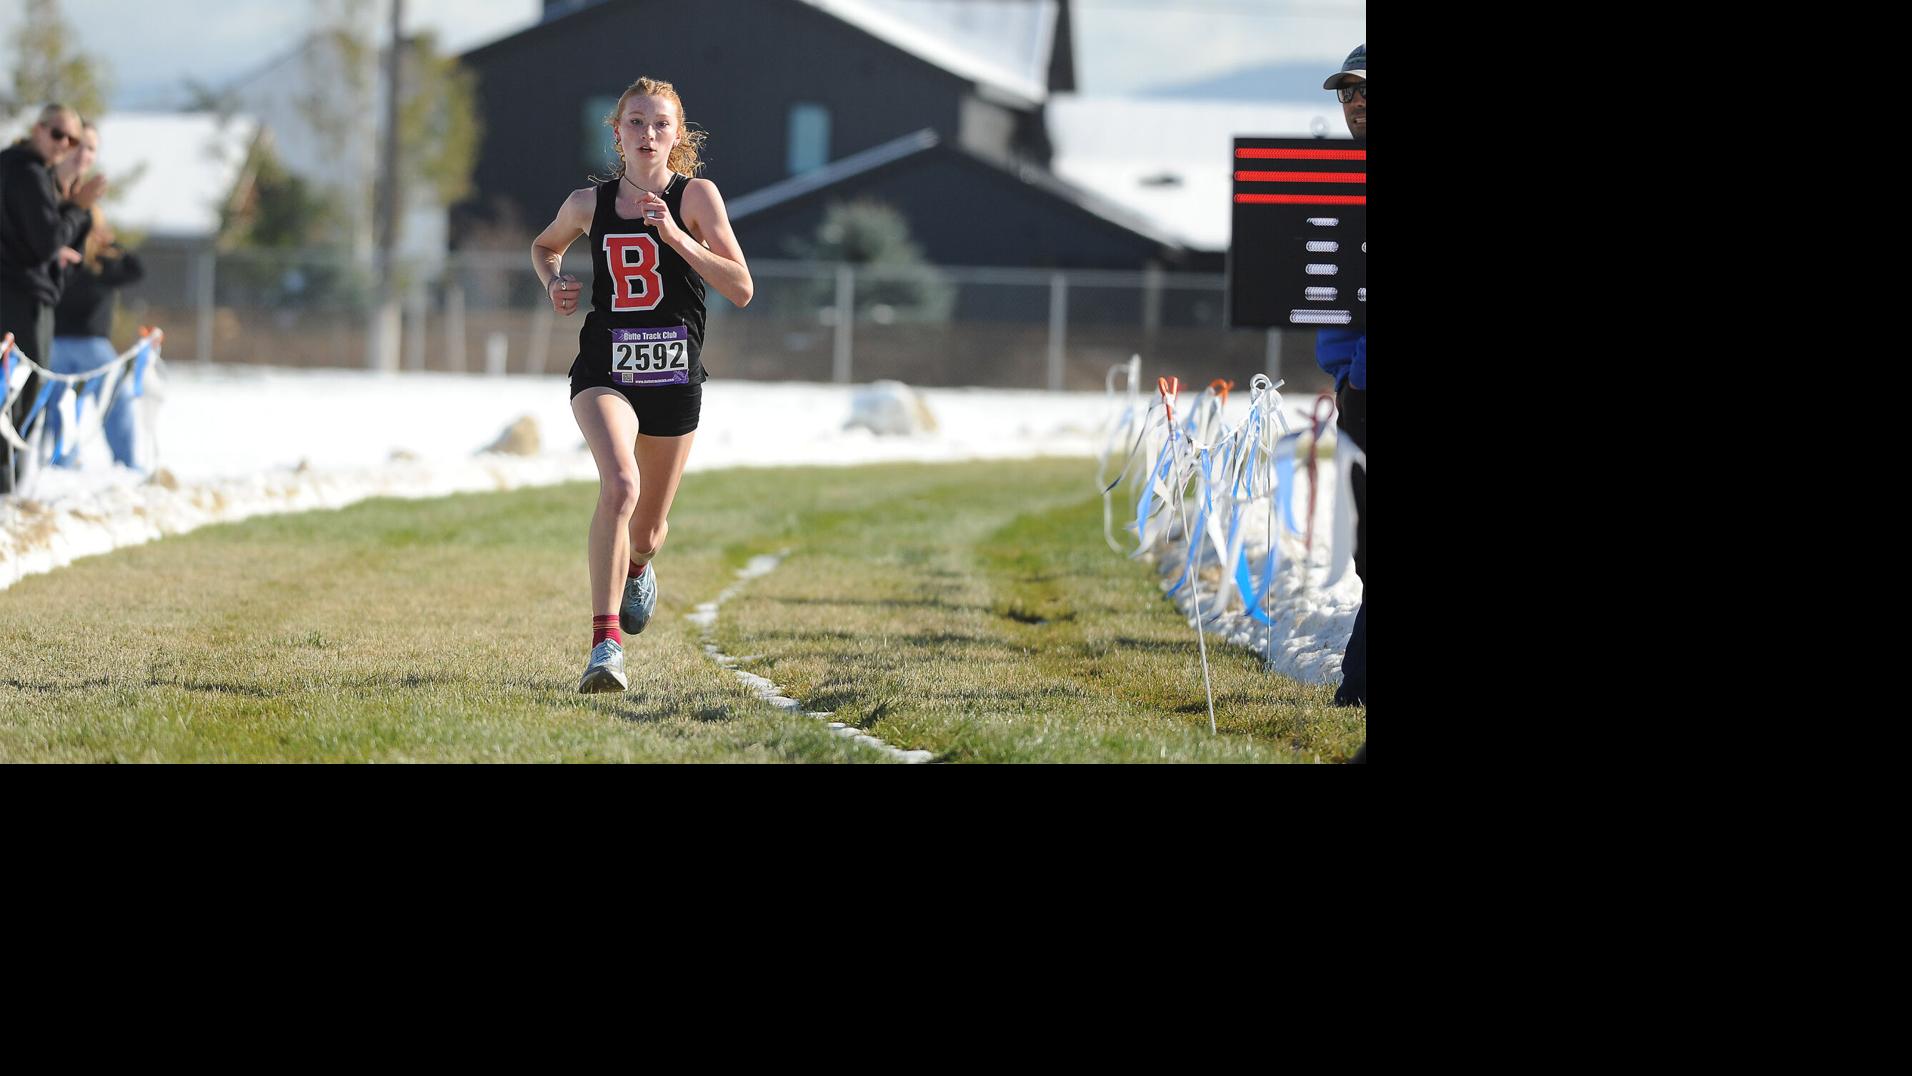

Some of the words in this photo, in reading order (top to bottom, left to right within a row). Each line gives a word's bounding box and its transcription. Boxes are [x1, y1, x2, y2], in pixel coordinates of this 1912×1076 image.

[603, 233, 664, 312] B
[642, 332, 661, 340] Track
[662, 331, 677, 339] Club
[616, 342, 685, 371] 2592
